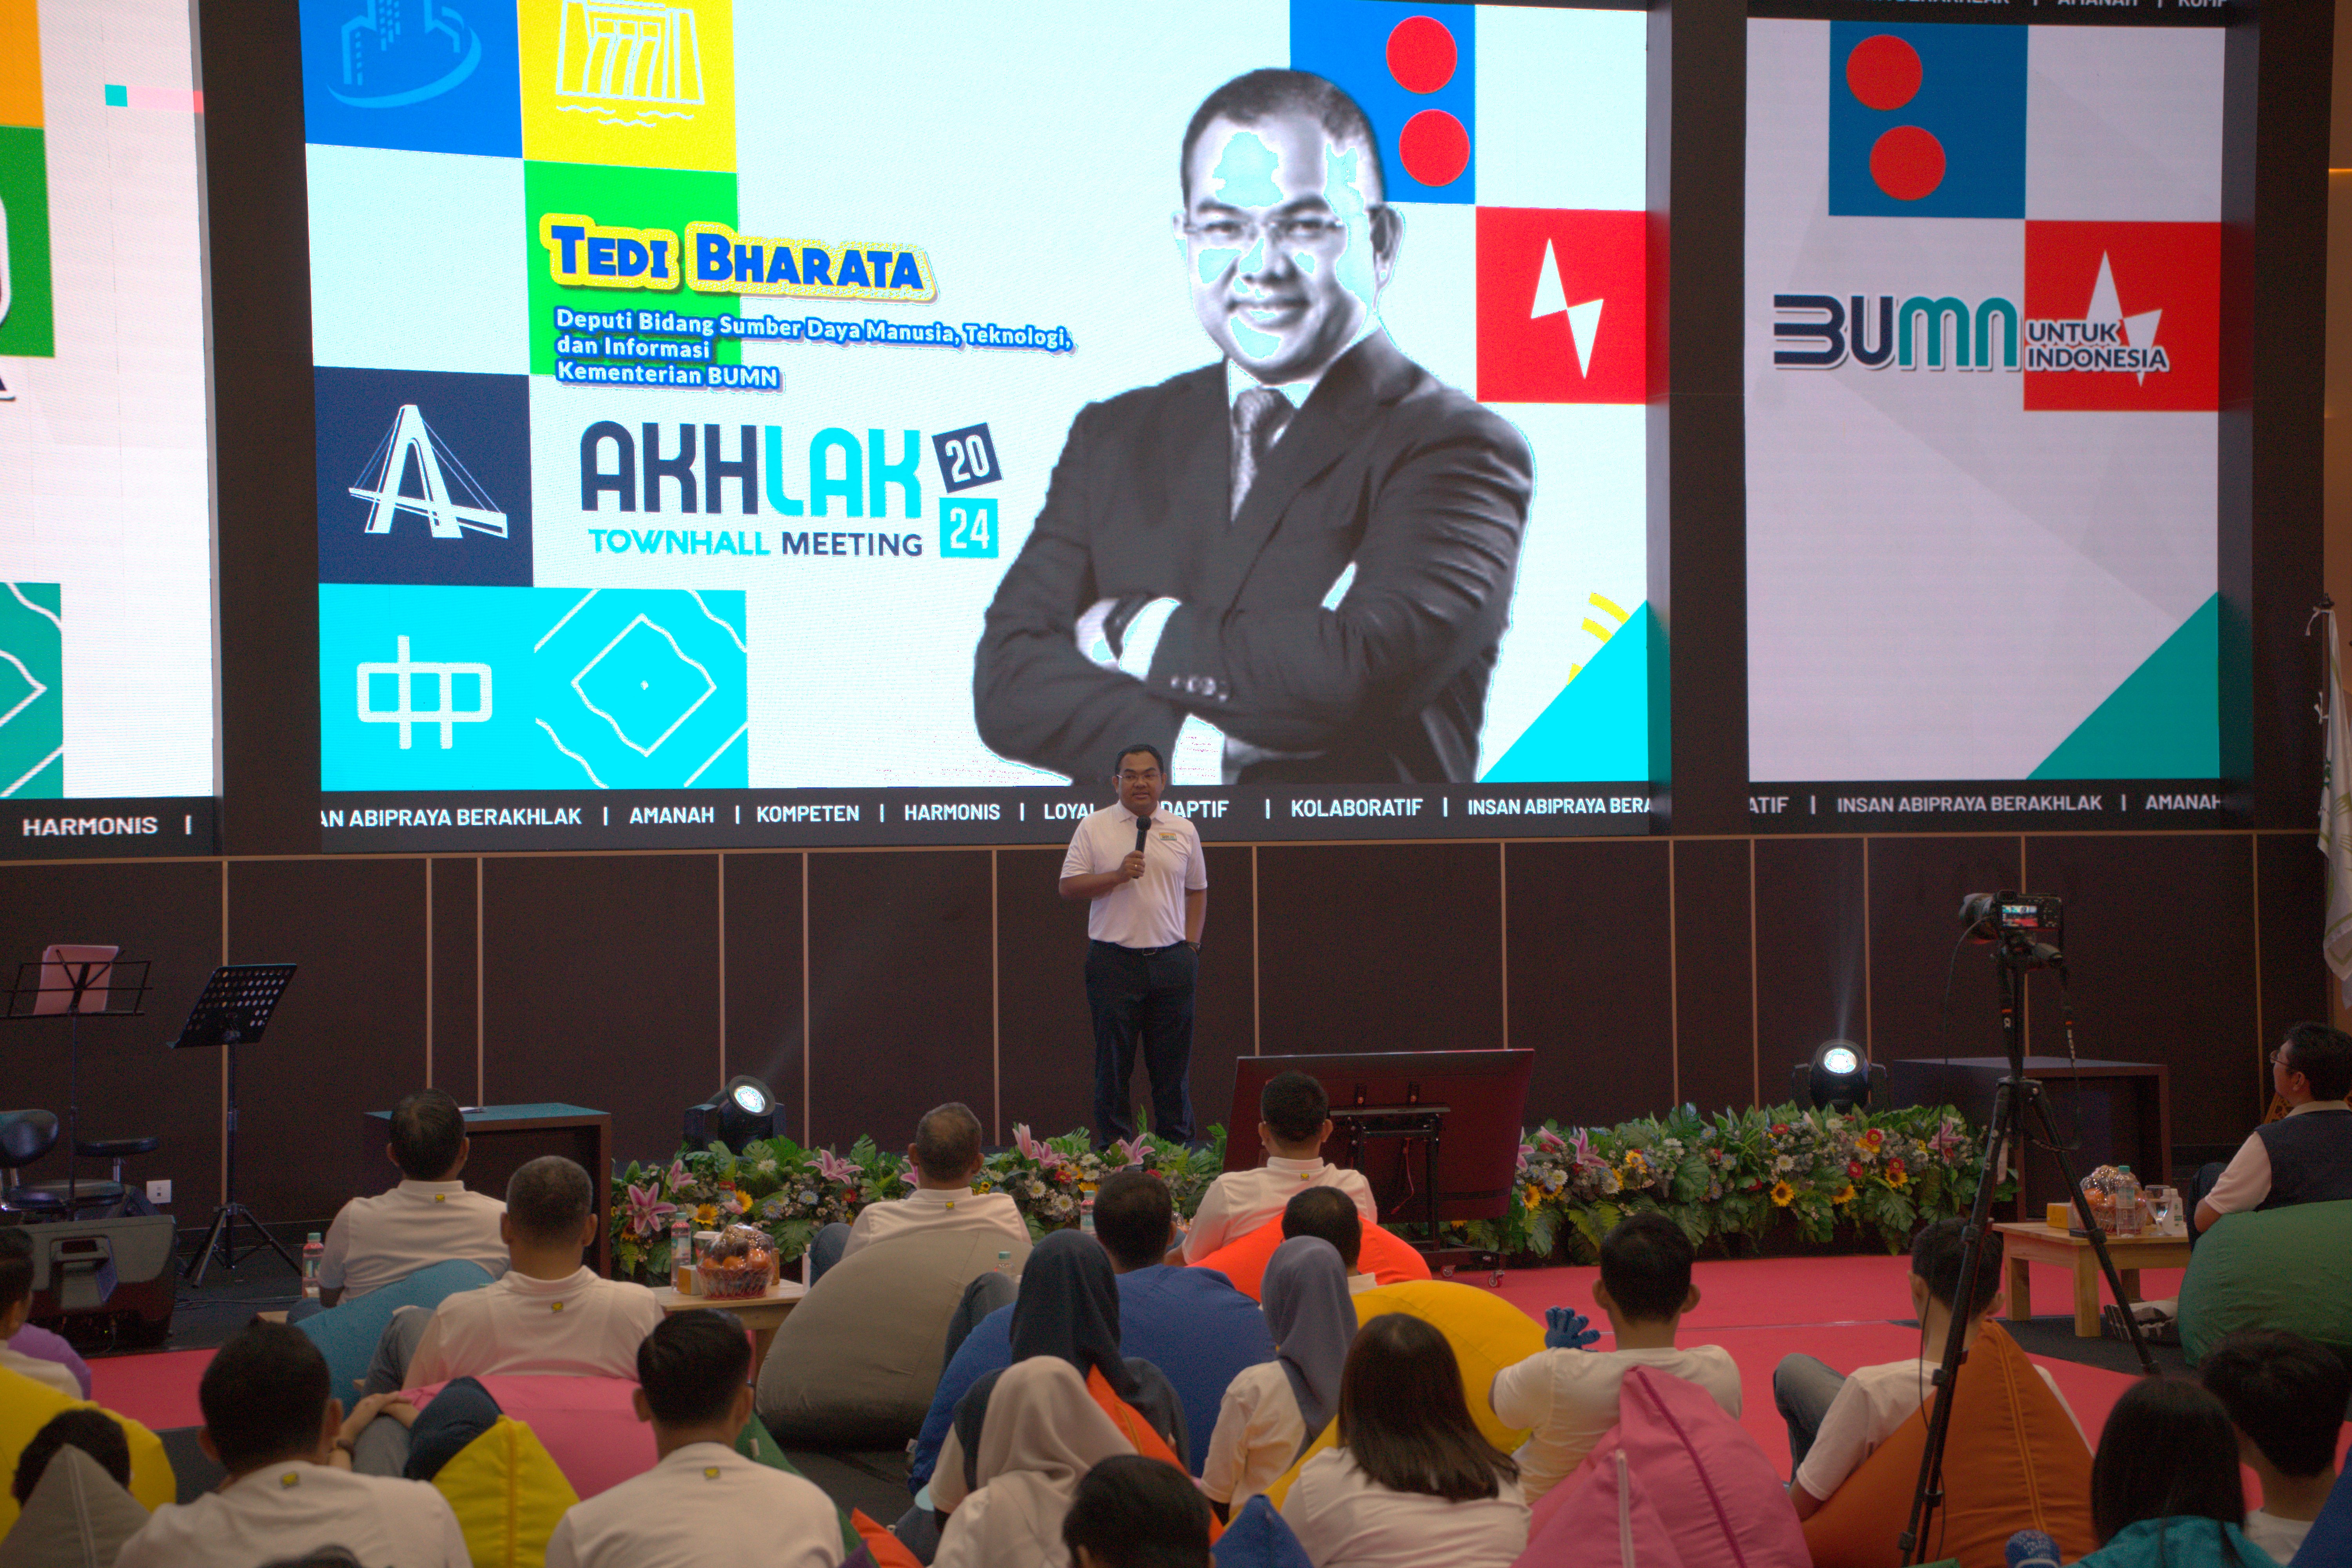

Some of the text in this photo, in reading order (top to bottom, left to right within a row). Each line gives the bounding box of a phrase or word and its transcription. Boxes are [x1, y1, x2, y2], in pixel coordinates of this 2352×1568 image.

[696, 233, 924, 290] BHARATA
[557, 309, 1071, 349] Deputi Bidang Sumber Daya Manusia, Teknologi,
[2028, 322, 2118, 343] UNTUK
[557, 335, 710, 358] dan Informasi
[2028, 348, 2167, 368] INDONESIA
[559, 361, 777, 386] Kementerian BUMN
[580, 420, 921, 518] AKHLAK
[945, 435, 990, 483] 20
[950, 507, 990, 549] 24
[588, 529, 922, 557] TOWNHALL MEETING
[349, 808, 452, 827] ABIPRAYA
[457, 808, 583, 826] BERAKHLAK
[629, 806, 715, 824] AMANAH
[757, 804, 860, 823] KOMPETEN
[904, 803, 1001, 821] HARMONIS
[1161, 800, 1230, 818] DAPTIF
[1291, 798, 1424, 817] KOLABORATIF
[1468, 798, 1521, 815] INSAN
[1524, 797, 1607, 815] ABIPRAYA
[1837, 797, 1894, 813] INSAN
[1898, 796, 1987, 813] ABIPRAYA
[1991, 795, 2103, 812] BERAKHLAK
[2145, 794, 2220, 810] AMANAH
[23, 817, 158, 836] HARMONIS
